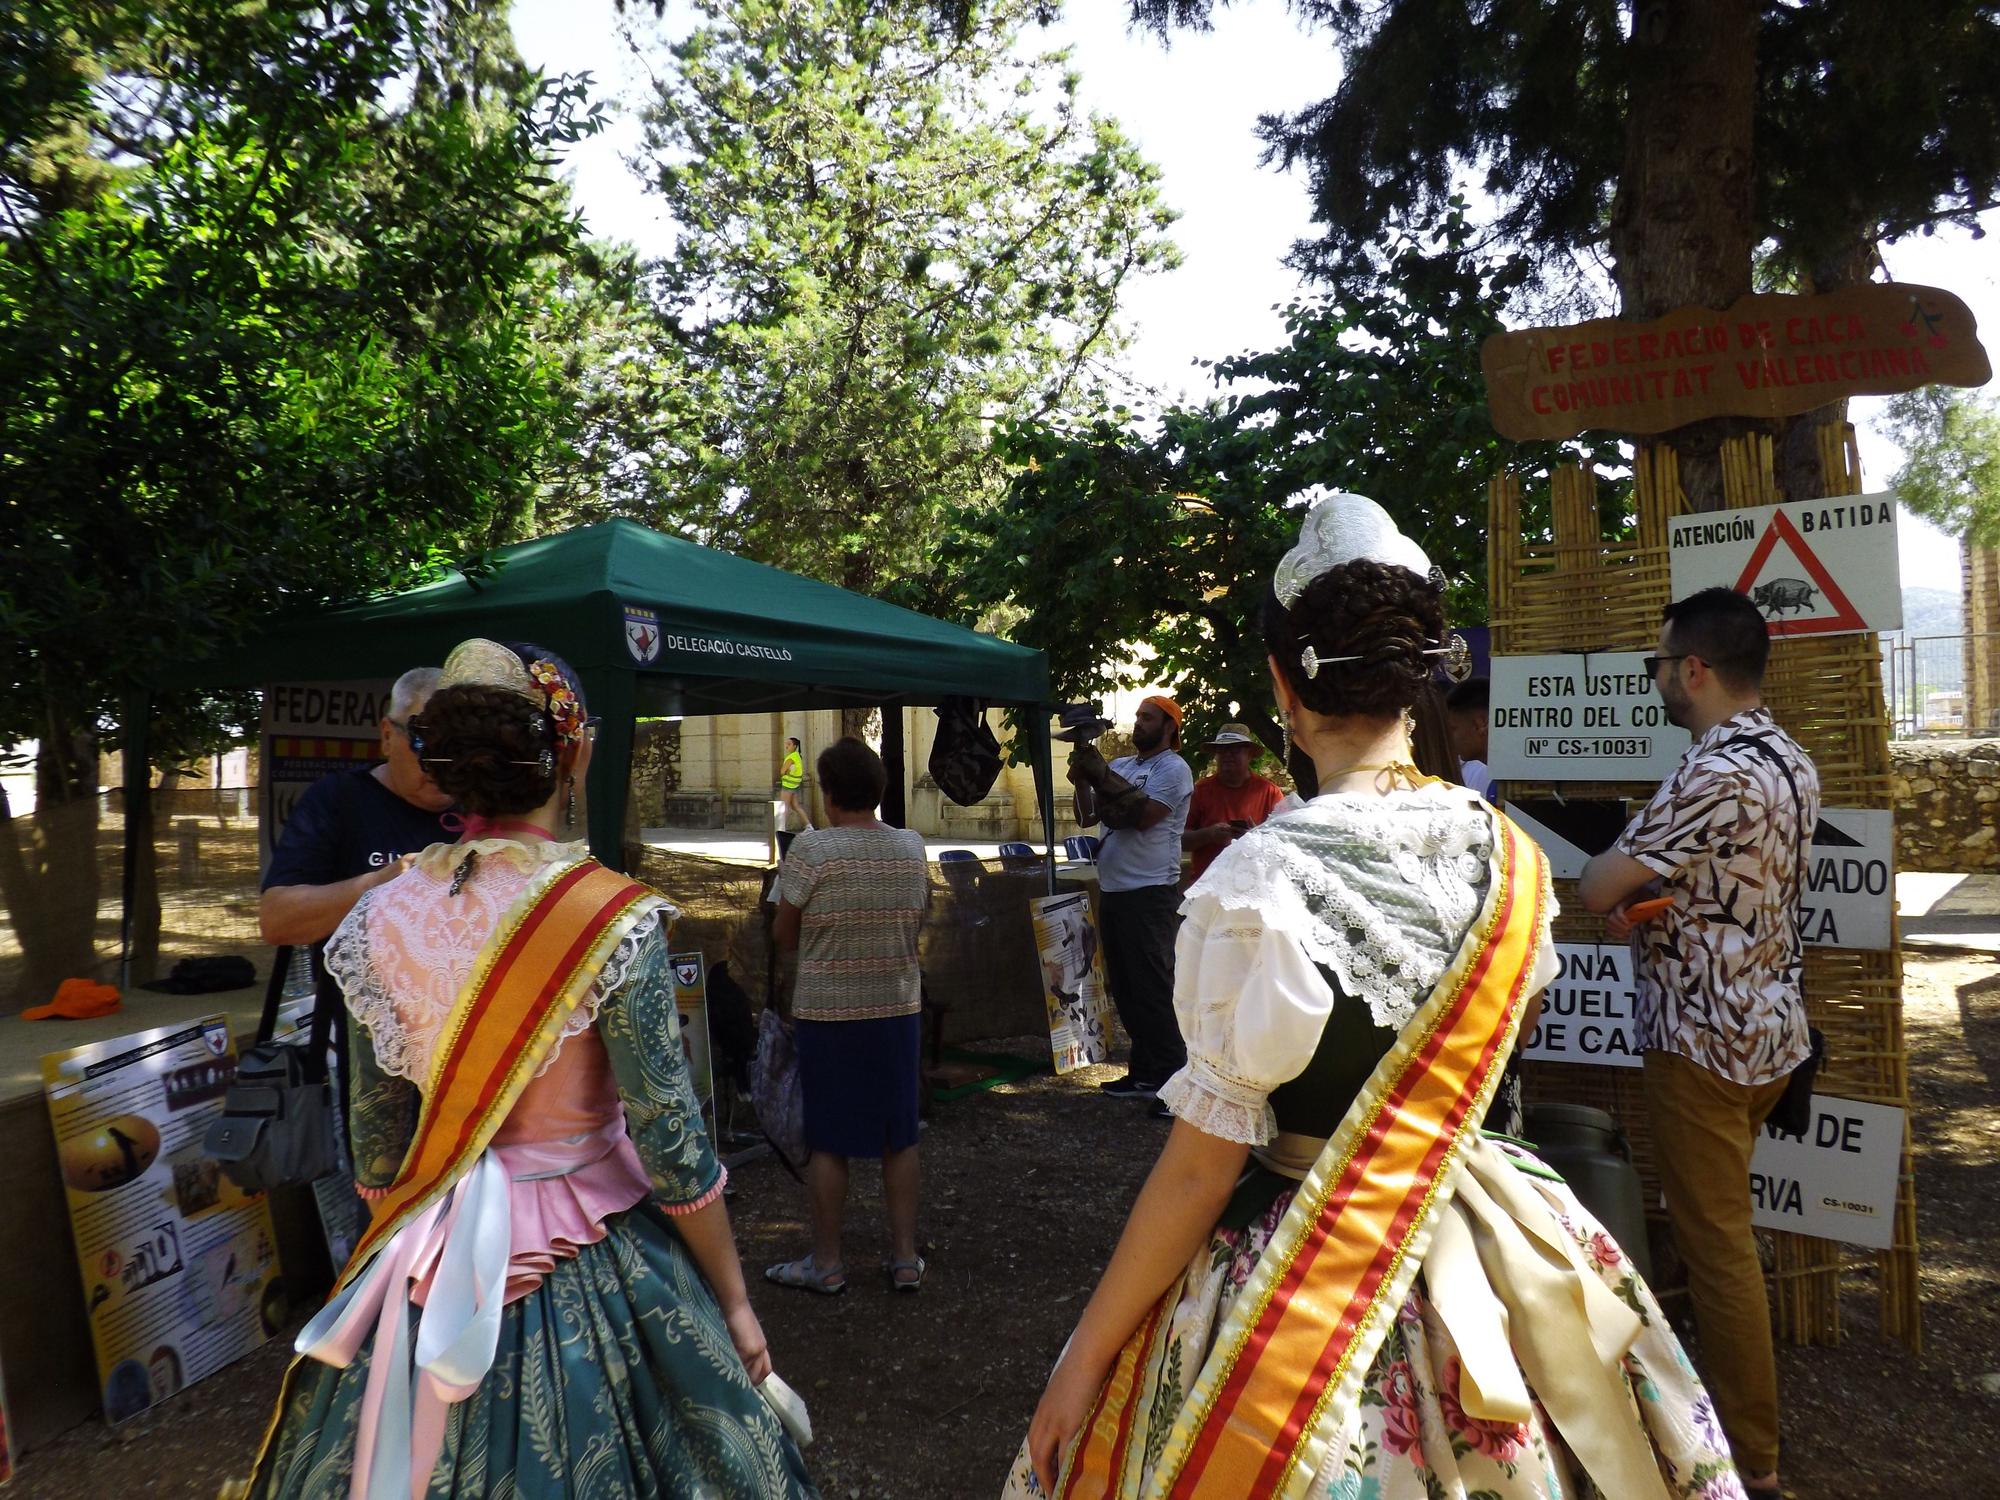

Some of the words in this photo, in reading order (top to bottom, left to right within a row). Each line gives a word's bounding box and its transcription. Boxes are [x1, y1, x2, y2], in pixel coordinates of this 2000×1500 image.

[1739, 320, 1775, 351] DE
[1532, 364, 1715, 415] COMUNITAT
[1737, 346, 1928, 391] VALENCIANA
[1672, 515, 1755, 549] ATENCIÓN
[1802, 502, 1892, 533] BATIDA
[1528, 675, 1575, 698] ESTA
[1585, 673, 1651, 697] USTED
[1494, 706, 1573, 729] DENTRO
[1583, 705, 1621, 728] DEL
[1816, 1113, 1864, 1154] DE
